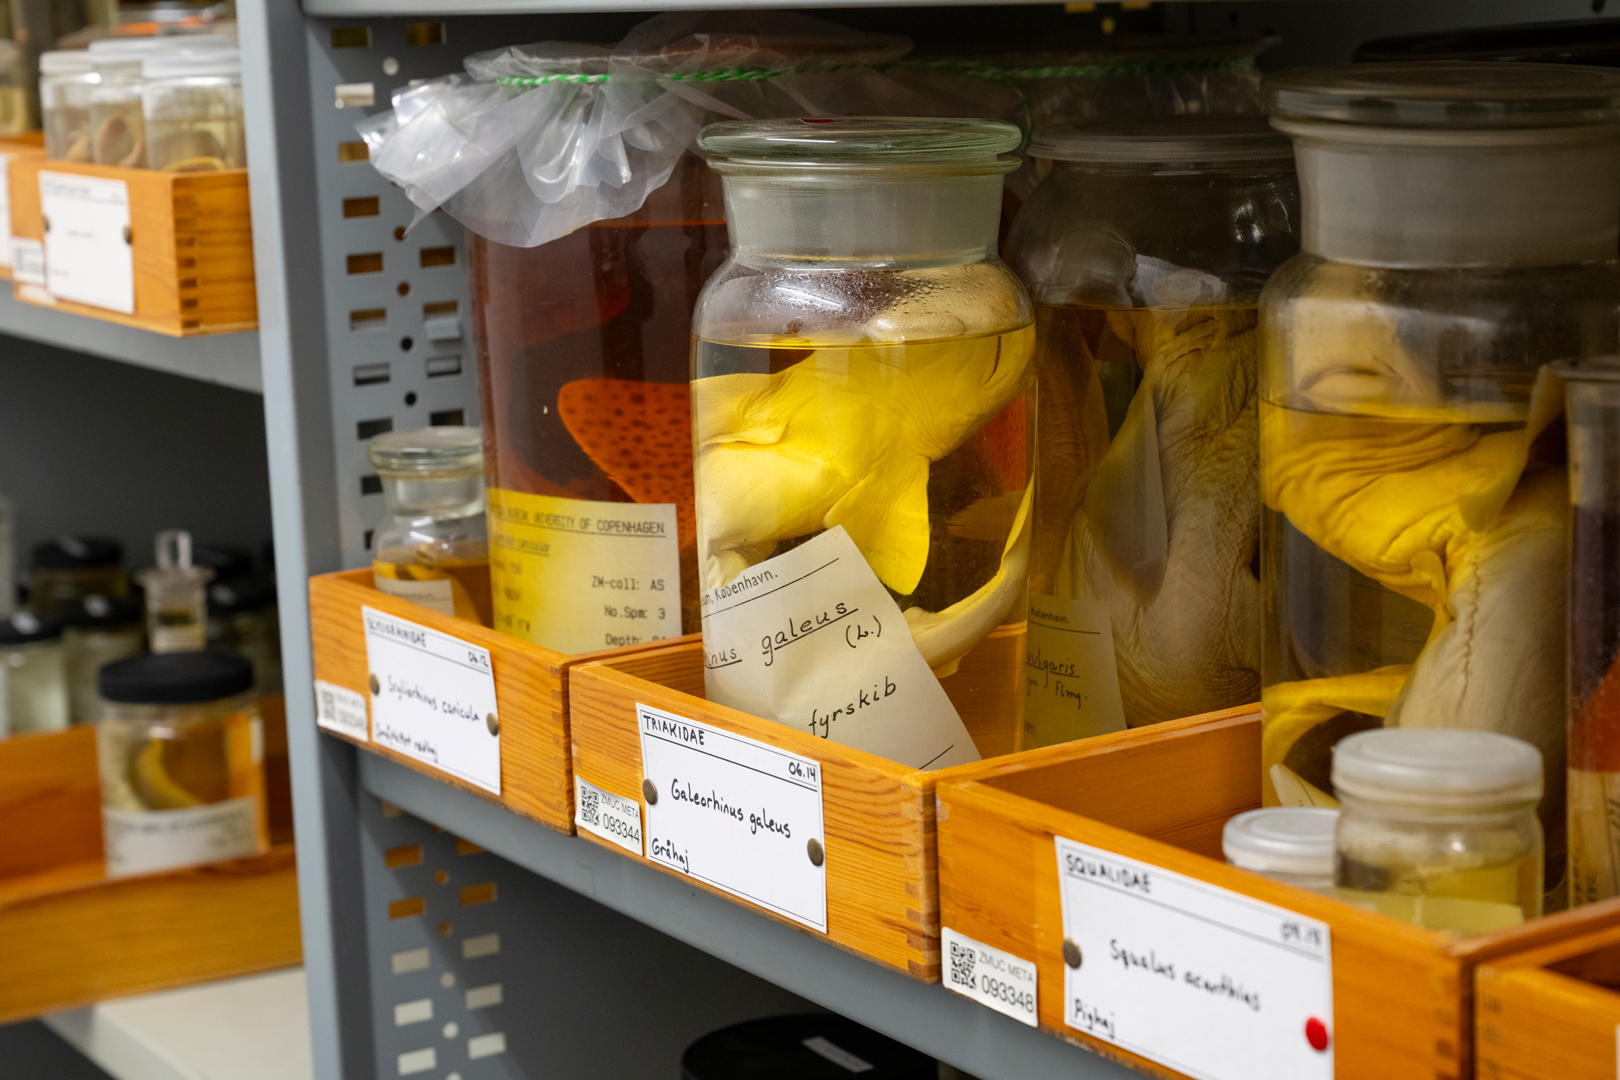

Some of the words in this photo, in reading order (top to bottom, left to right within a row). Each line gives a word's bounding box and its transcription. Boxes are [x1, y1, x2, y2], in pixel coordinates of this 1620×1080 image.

[534, 512, 575, 528] UNIVERSITY
[579, 518, 591, 530] OF
[597, 521, 665, 534] COPENHAGEN
[592, 575, 640, 590] ZM-coll:
[650, 578, 665, 591] AS
[714, 570, 778, 601] København.
[658, 607, 666, 619] 3
[1030, 606, 1070, 624] København.
[605, 633, 642, 646] Depth:
[761, 601, 849, 667] galeus
[1027, 647, 1075, 689] vulgaris
[809, 675, 897, 738] fyrskib
[643, 714, 706, 746] TRIAKIDAE
[788, 762, 817, 783] 06.14
[601, 793, 621, 812] ZMUC
[621, 801, 640, 819] META
[671, 777, 744, 822] Galeorhinus
[749, 807, 792, 838] galeus
[603, 812, 641, 845] 093344
[651, 837, 690, 874] Gråhaj
[1065, 853, 1153, 894] SQUALIDAE
[978, 950, 1006, 973] ZMUC
[1007, 963, 1034, 984] META
[1110, 938, 1176, 982] Squalus
[1185, 968, 1262, 1012] acanthias
[981, 973, 1034, 1014] 093348
[1074, 998, 1117, 1040] Pighaj
